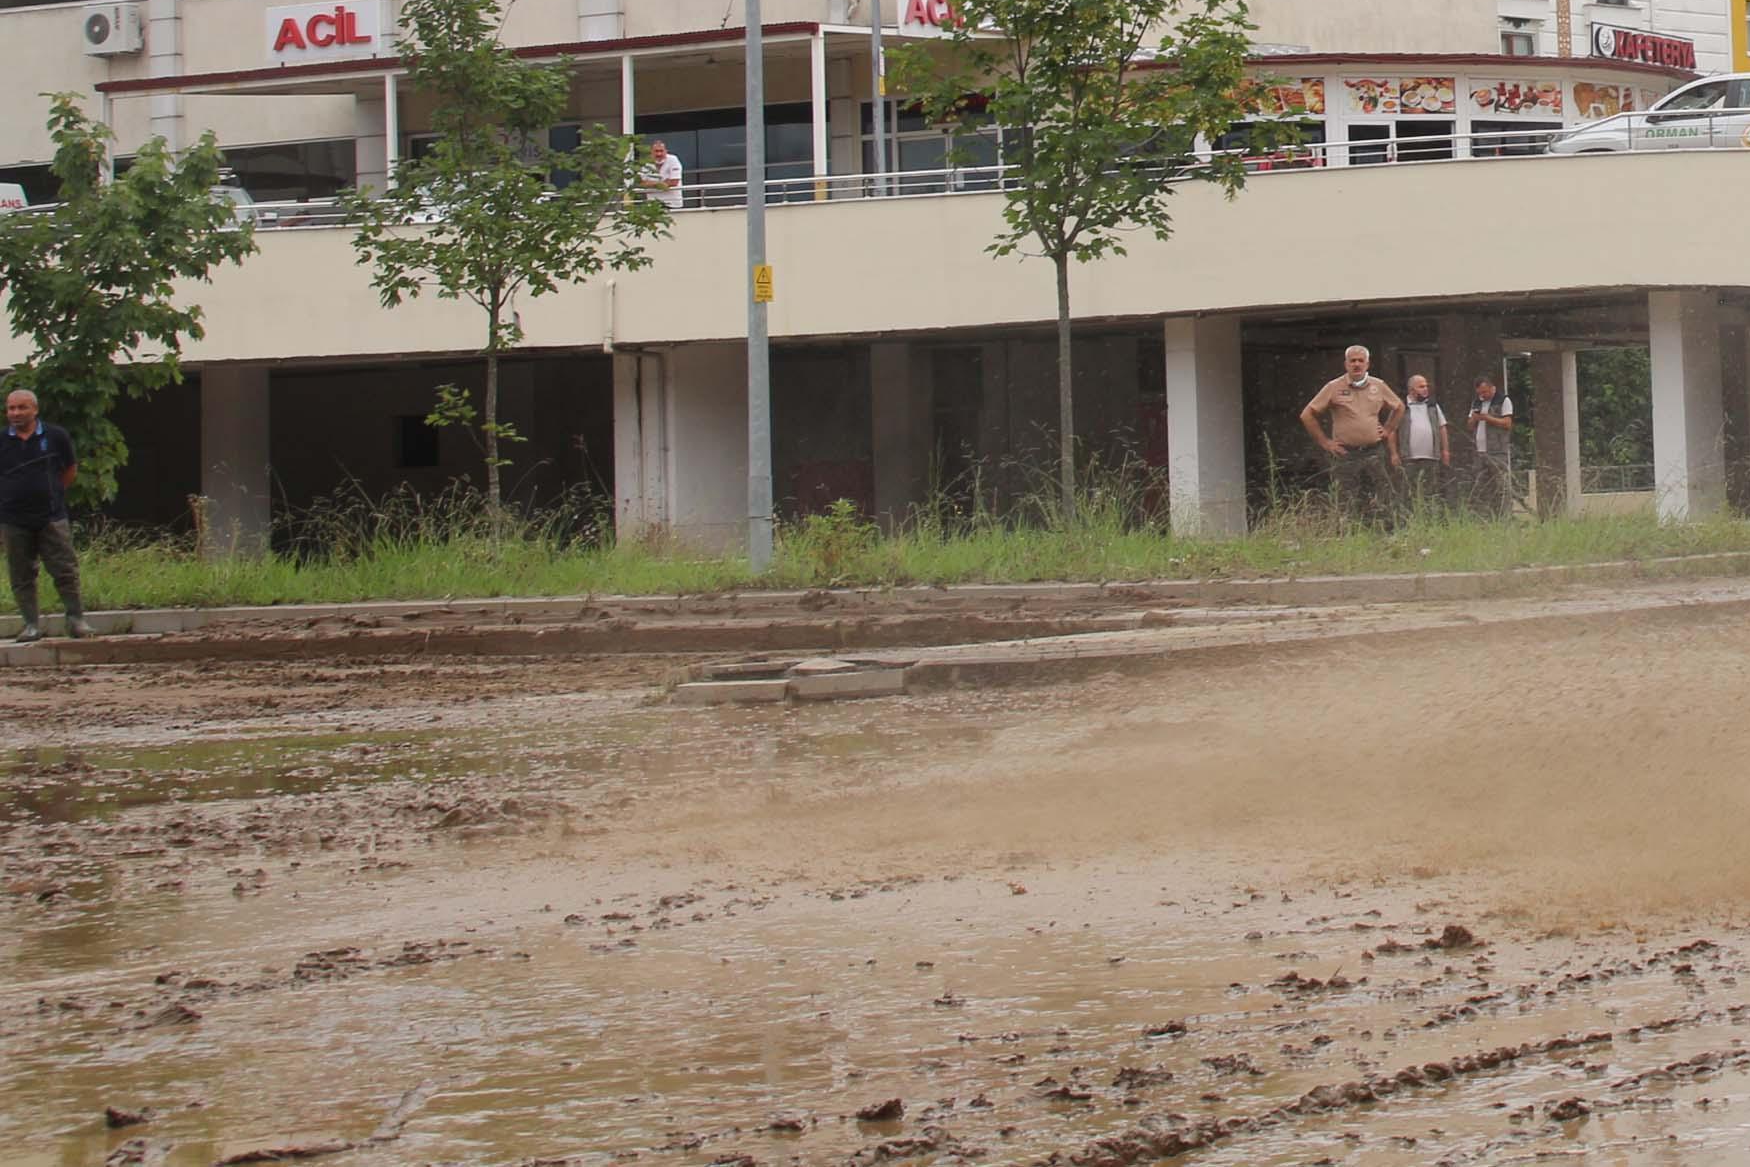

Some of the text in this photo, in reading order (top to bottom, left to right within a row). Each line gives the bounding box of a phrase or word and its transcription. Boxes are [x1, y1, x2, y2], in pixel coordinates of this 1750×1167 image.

[274, 6, 371, 51] ACİL
[1615, 30, 1696, 68] KAFETERYA
[1645, 127, 1698, 138] ORMAN
